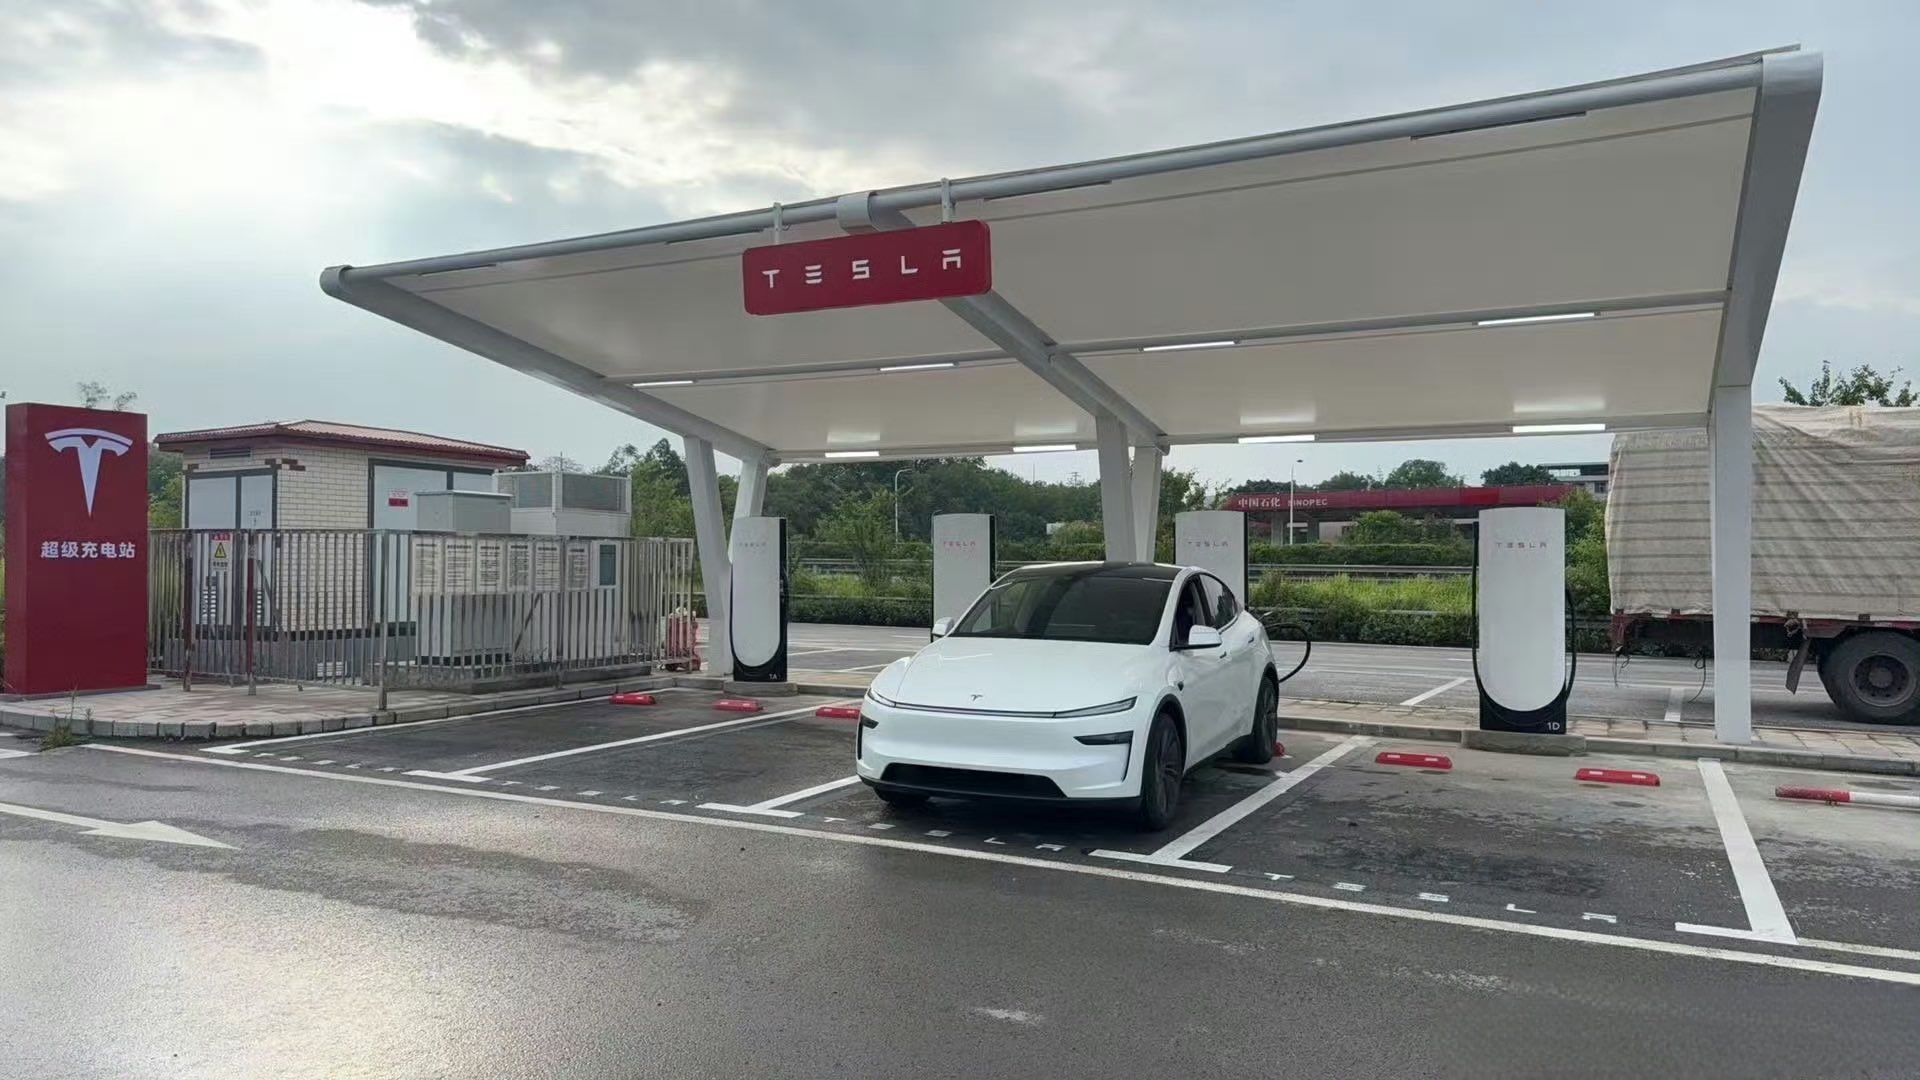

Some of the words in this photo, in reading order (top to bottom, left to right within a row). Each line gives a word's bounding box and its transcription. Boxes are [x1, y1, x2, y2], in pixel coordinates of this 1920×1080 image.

[762, 248, 961, 289] TESLA
[1238, 497, 1280, 508] 中国石化
[40, 541, 136, 559] 超级充电站
[1547, 721, 1561, 731] 1D
